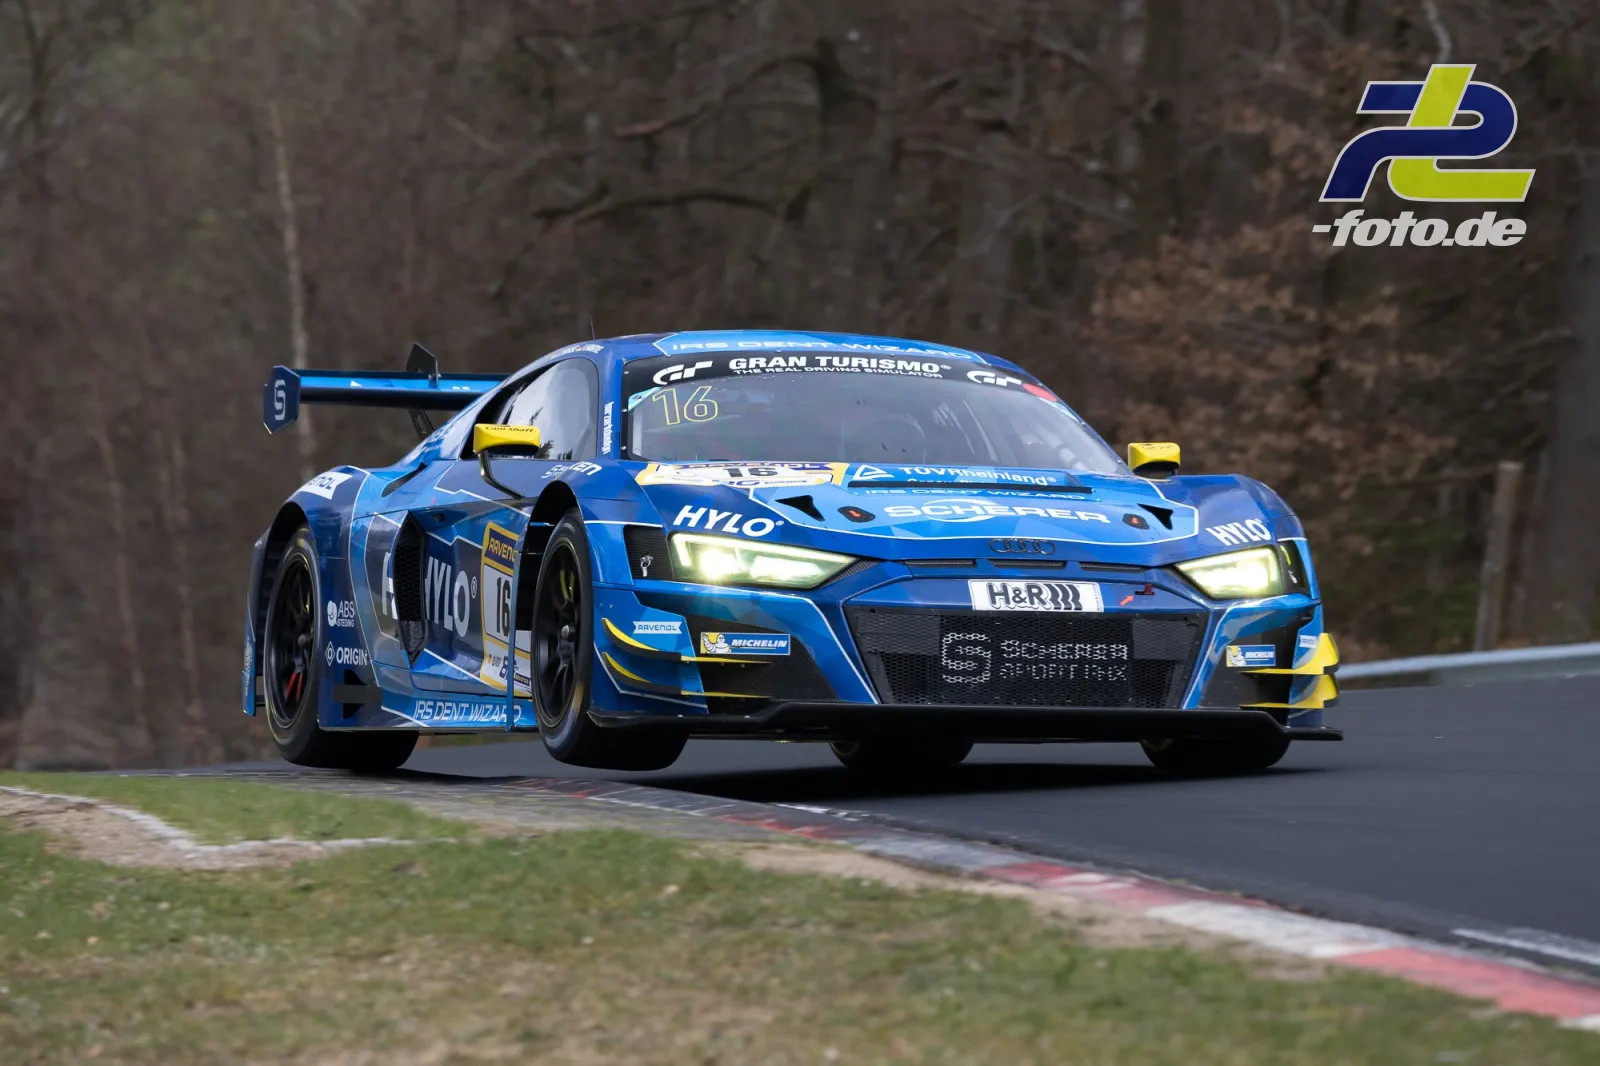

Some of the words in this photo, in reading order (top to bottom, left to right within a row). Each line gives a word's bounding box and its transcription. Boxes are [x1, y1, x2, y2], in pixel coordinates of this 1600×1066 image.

[672, 342, 728, 350] IRS
[842, 342, 972, 359] WIZARD
[729, 357, 806, 370] GRAN
[863, 367, 943, 379] SIMULATOR
[652, 385, 719, 426] 16
[724, 467, 778, 478] 16
[986, 489, 1086, 500] WIZARD
[883, 504, 1112, 524] SCHERER
[986, 582, 1052, 610] H&R
[337, 600, 355, 618] ABS
[496, 577, 512, 637] 16
[637, 624, 678, 632] RAVENOL
[731, 638, 788, 648] MICHELIN
[336, 646, 368, 666] ORIGIN
[413, 700, 434, 720] IRS
[432, 701, 470, 721] DENT
